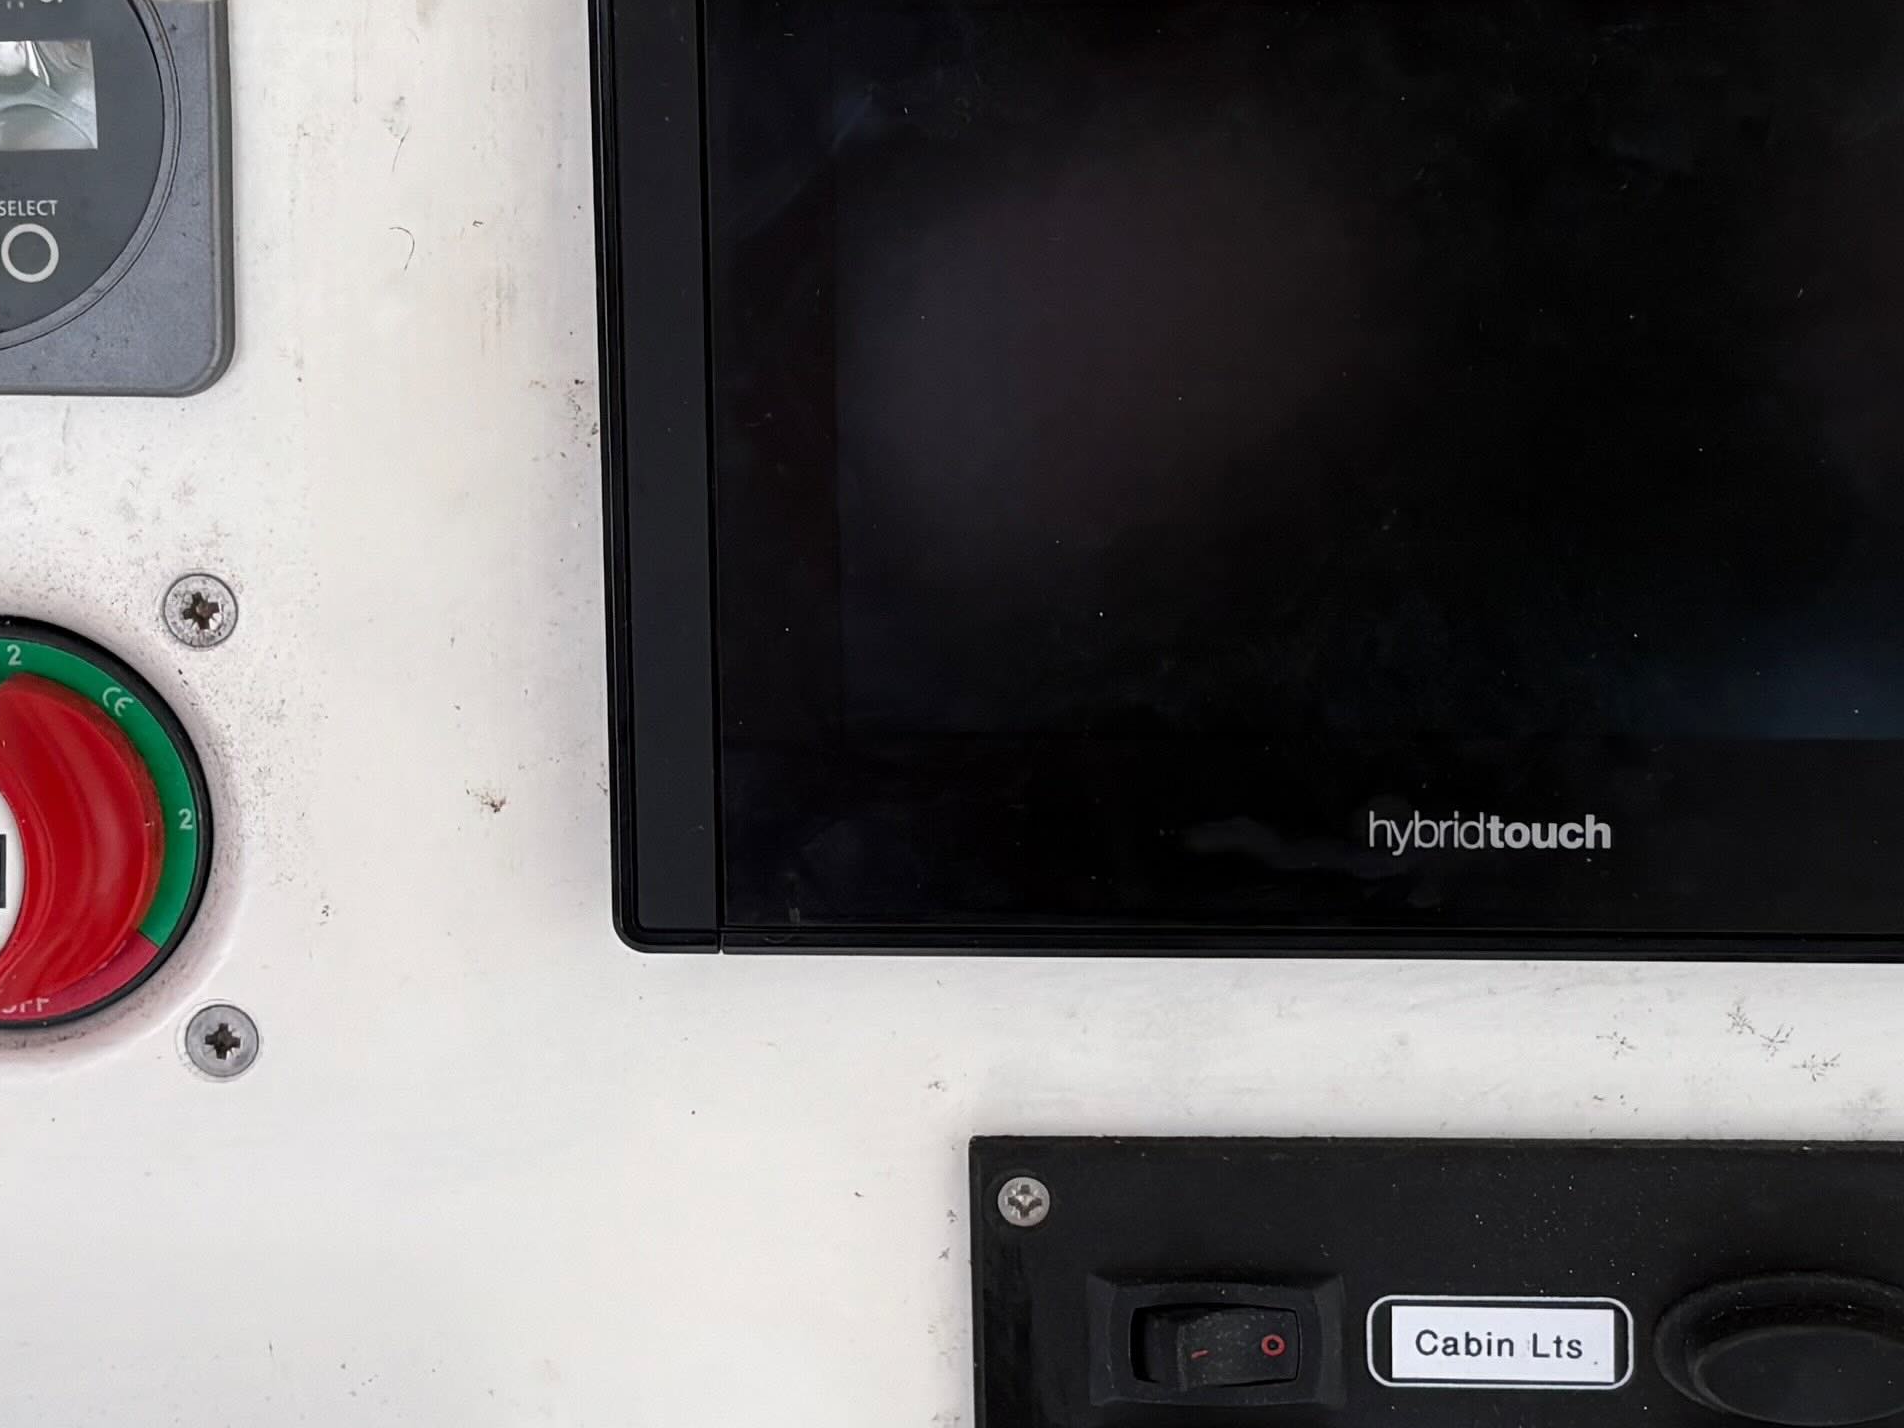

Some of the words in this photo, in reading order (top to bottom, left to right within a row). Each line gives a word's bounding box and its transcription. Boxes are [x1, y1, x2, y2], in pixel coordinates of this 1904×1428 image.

[7, 645, 22, 666] 2
[178, 808, 193, 830] 2
[1369, 810, 1612, 856] hybridtouch
[1415, 1329, 1515, 1358] Cabin
[1532, 1332, 1583, 1360] Lts
